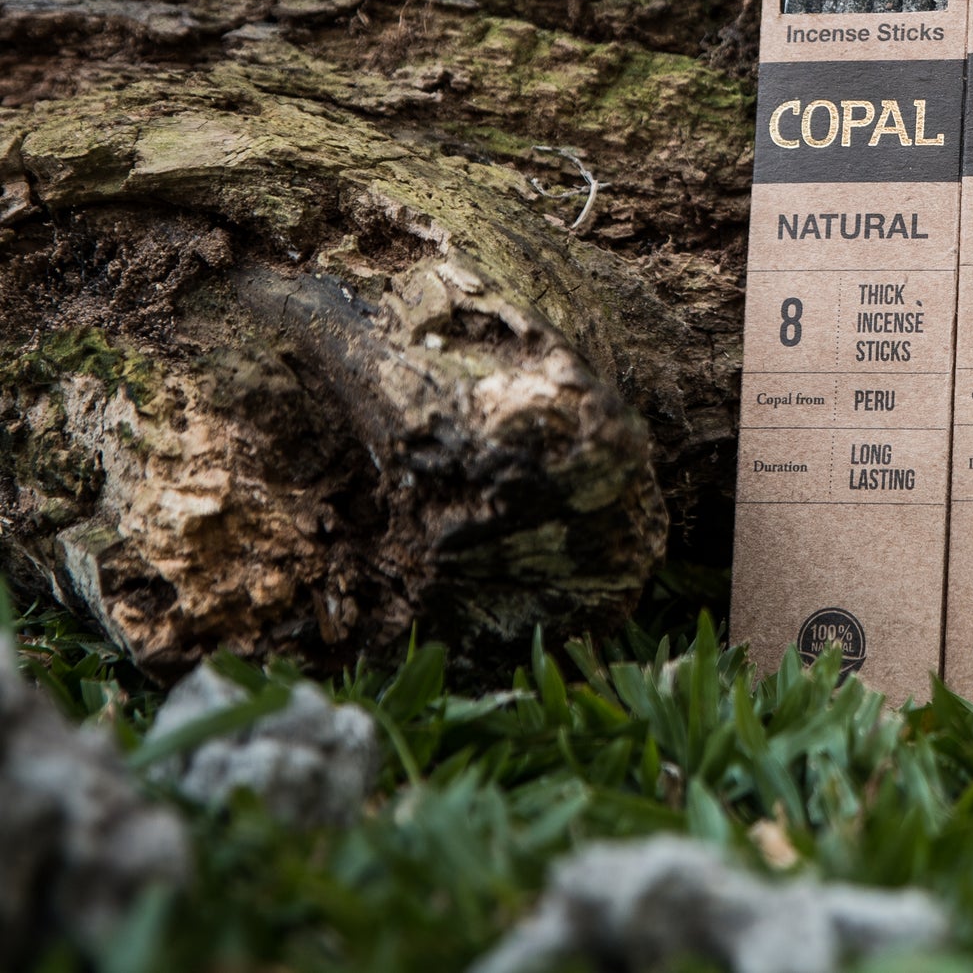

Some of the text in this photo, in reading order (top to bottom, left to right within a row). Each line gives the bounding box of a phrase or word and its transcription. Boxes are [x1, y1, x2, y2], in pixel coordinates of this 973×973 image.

[786, 23, 945, 43] Incense Sticks
[769, 99, 945, 149] COPAL
[778, 213, 929, 240] NATURAL
[858, 284, 905, 306] THICK
[779, 297, 804, 347] 8
[857, 312, 924, 334] INCENSE
[855, 340, 911, 362] STICKS
[756, 393, 825, 408] Copal from
[854, 390, 896, 412] PERU
[851, 444, 892, 465] LONG
[753, 460, 808, 473] Duration
[849, 469, 916, 491] LASTING
[811, 624, 853, 641] 100%
[811, 642, 854, 652] NAAL
